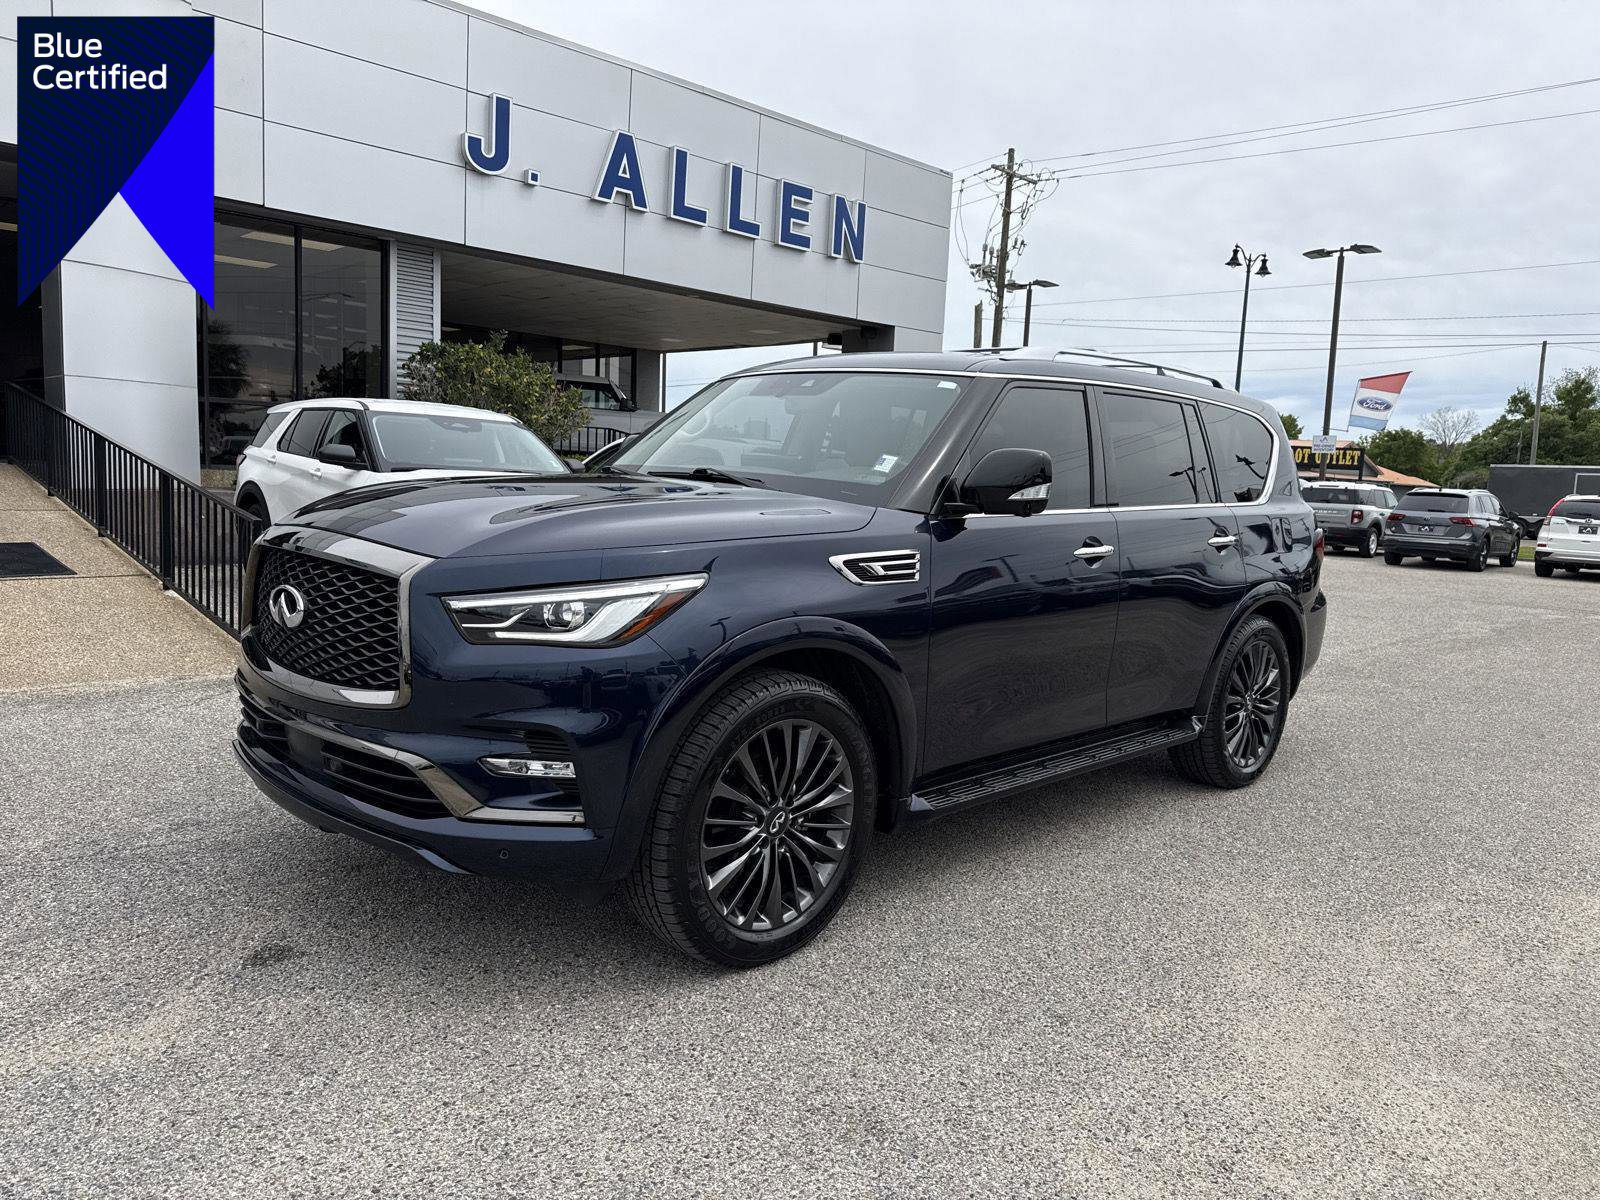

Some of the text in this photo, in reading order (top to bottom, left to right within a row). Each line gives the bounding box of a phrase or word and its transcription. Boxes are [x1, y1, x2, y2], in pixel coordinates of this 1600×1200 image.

[462, 92, 868, 264] J. ALLEN
[1363, 399, 1387, 410] Ford
